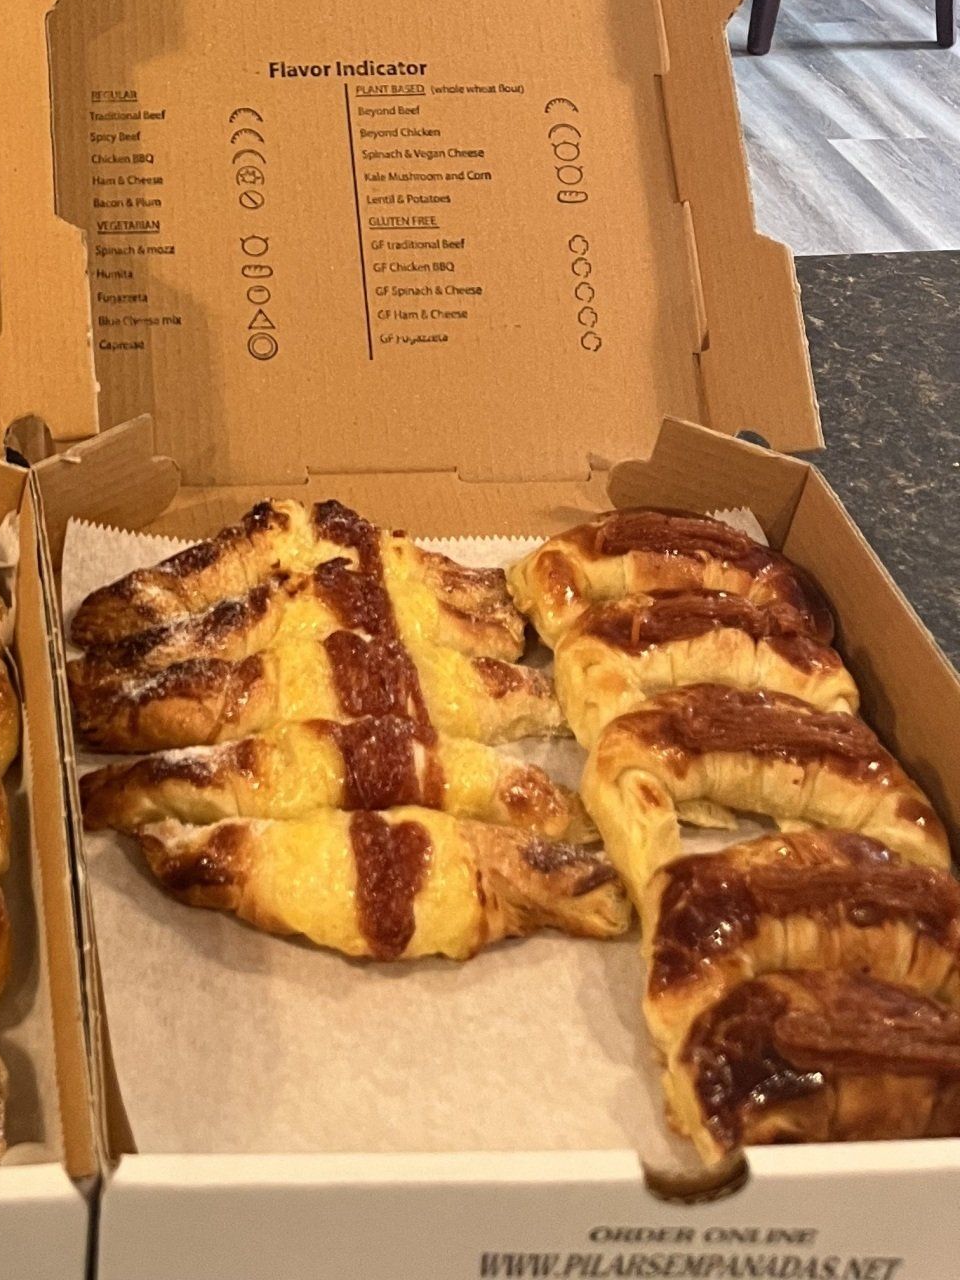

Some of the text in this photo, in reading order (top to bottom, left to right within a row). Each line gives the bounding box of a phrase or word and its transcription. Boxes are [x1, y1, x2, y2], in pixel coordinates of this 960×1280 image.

[269, 60, 427, 79] Flavor Indicator
[356, 85, 388, 94] PLANT
[392, 84, 425, 93] BASED
[358, 105, 420, 118] Beyond Beef
[360, 127, 440, 140] Beyond Chicken
[362, 150, 402, 160] Spinach
[414, 149, 445, 160] Vegan
[447, 148, 485, 158] Cheese
[364, 173, 386, 182] Kale
[445, 171, 465, 180] and
[467, 171, 492, 180] Corn
[367, 194, 396, 204] Lentil
[588, 1226, 819, 1243] ORDER ONLINE
[479, 1253, 904, 1280] WWW.PILARSEMPANADASNET
